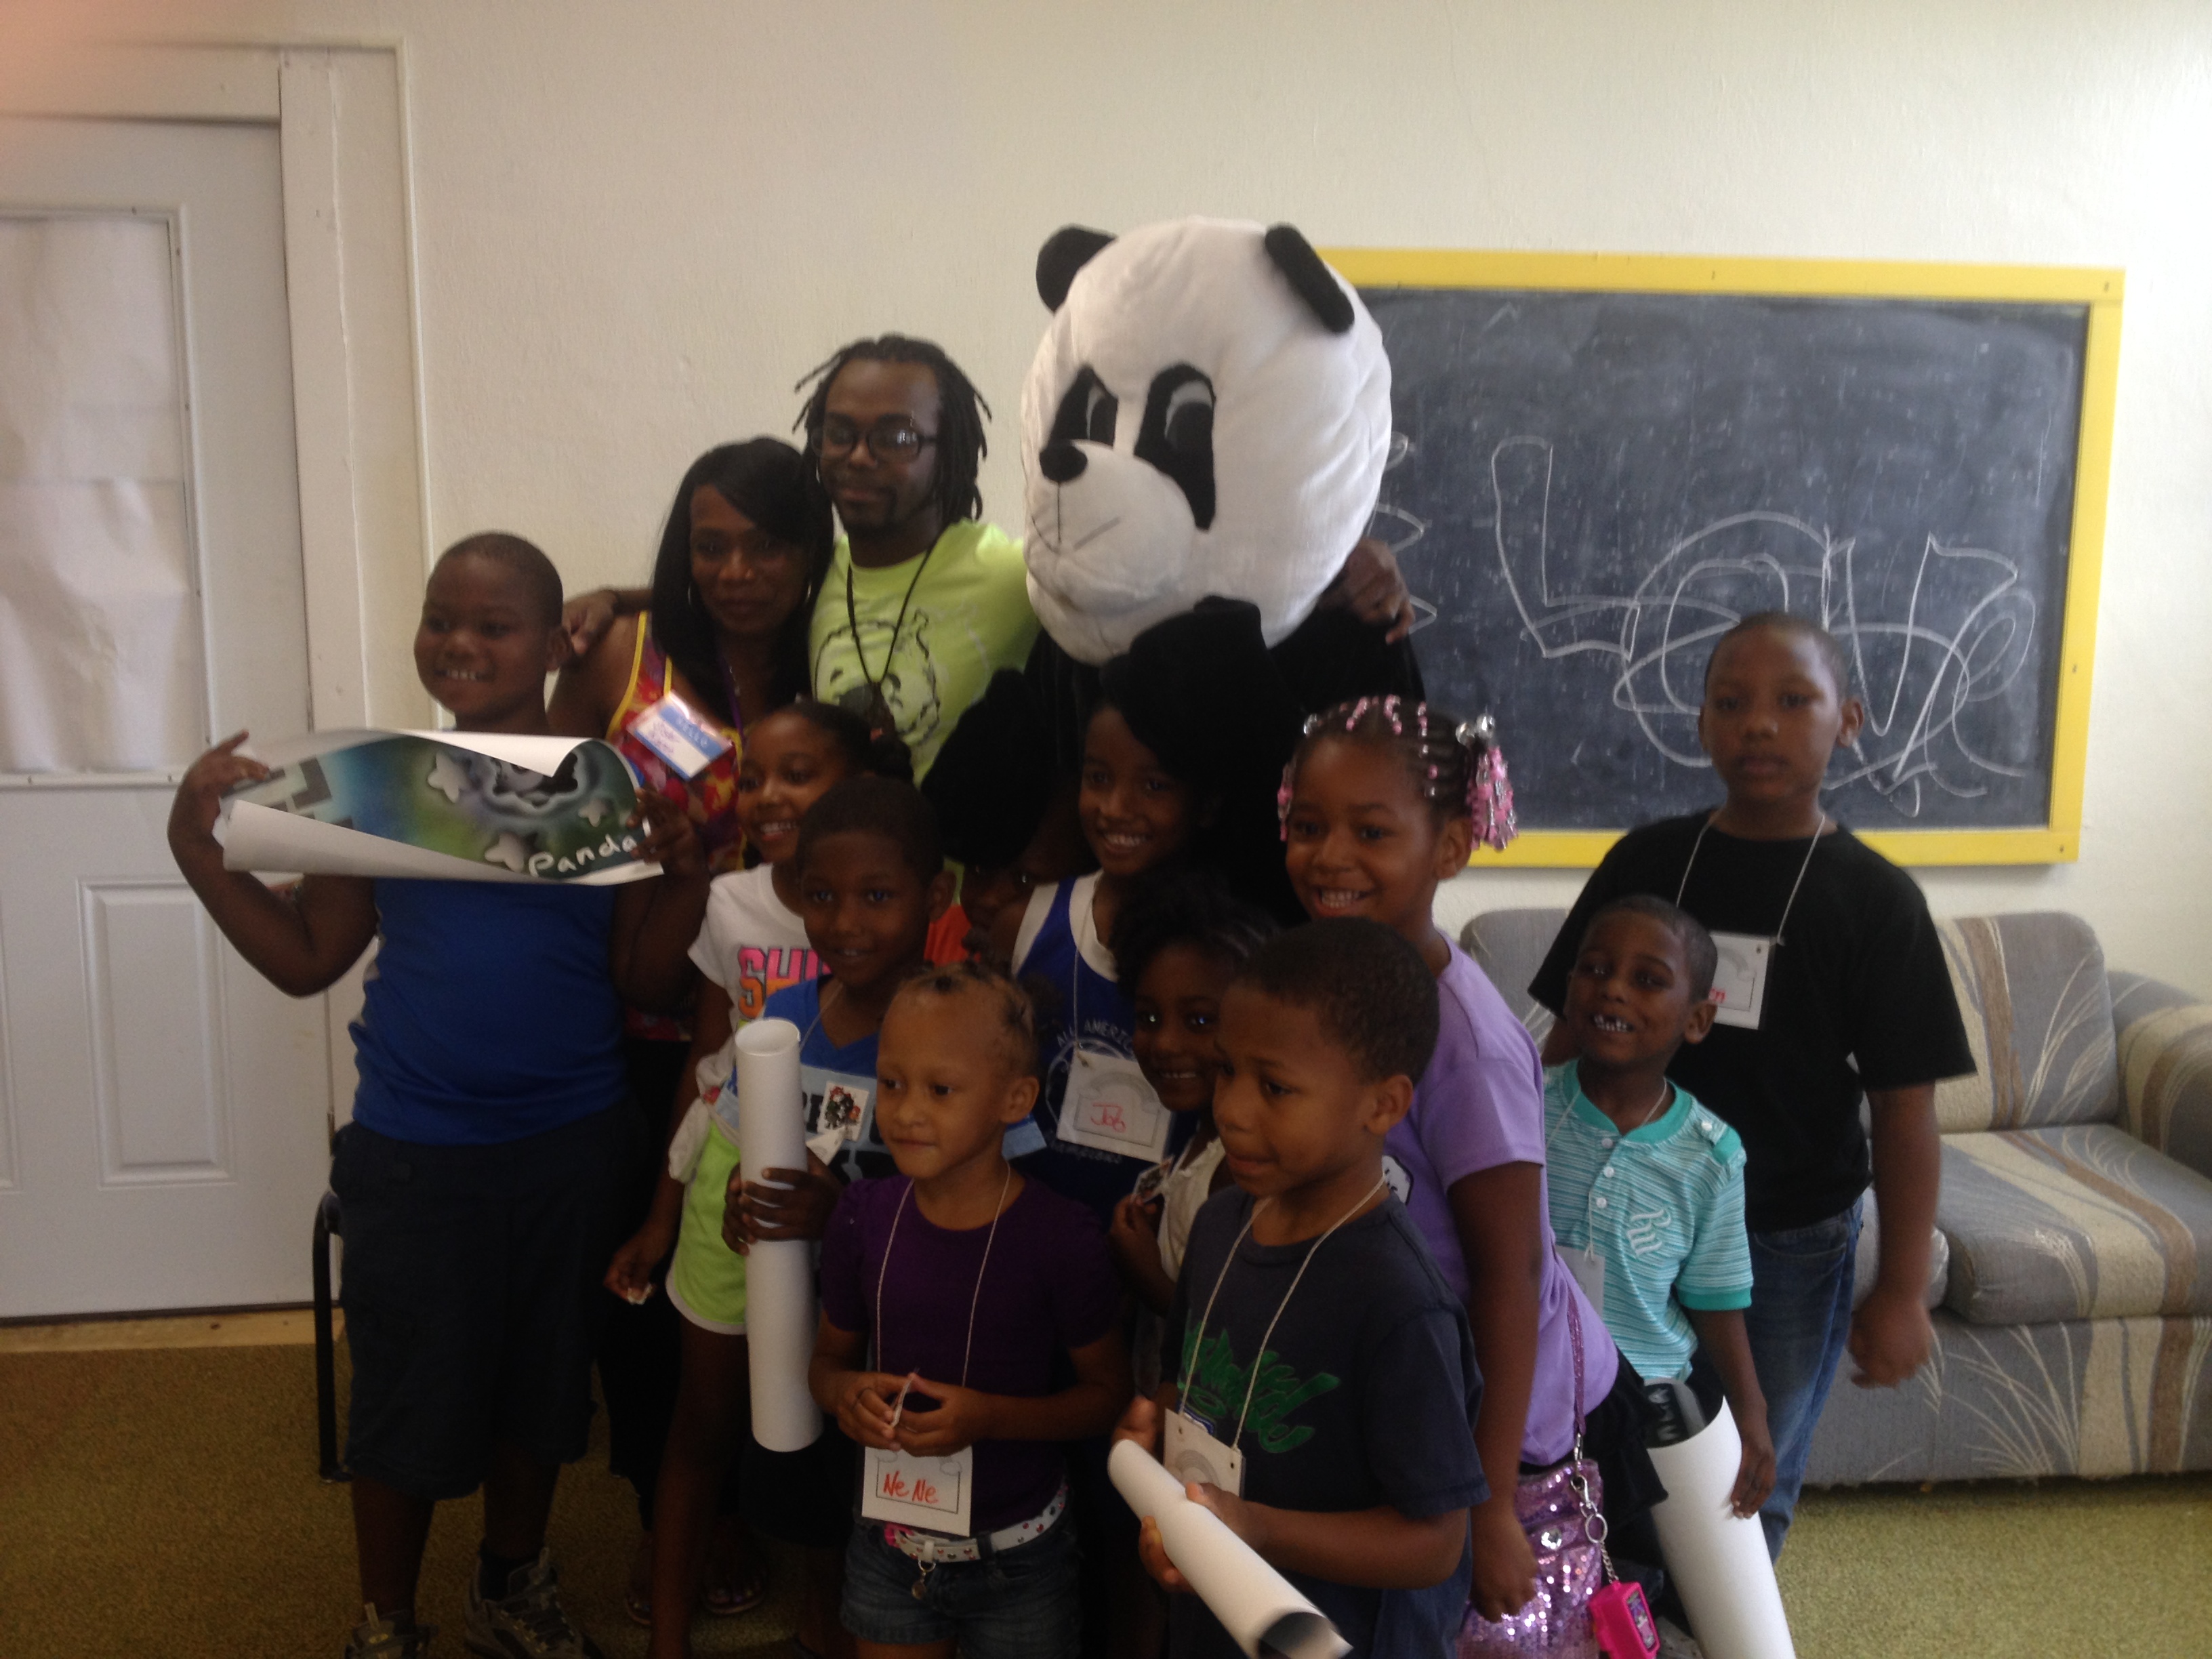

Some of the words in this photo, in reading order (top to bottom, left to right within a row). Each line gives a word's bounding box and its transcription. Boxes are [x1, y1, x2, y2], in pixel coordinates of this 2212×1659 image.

[529, 833, 638, 878] Panda
[883, 1471, 909, 1497] Ne
[912, 1479, 940, 1504] Ne
